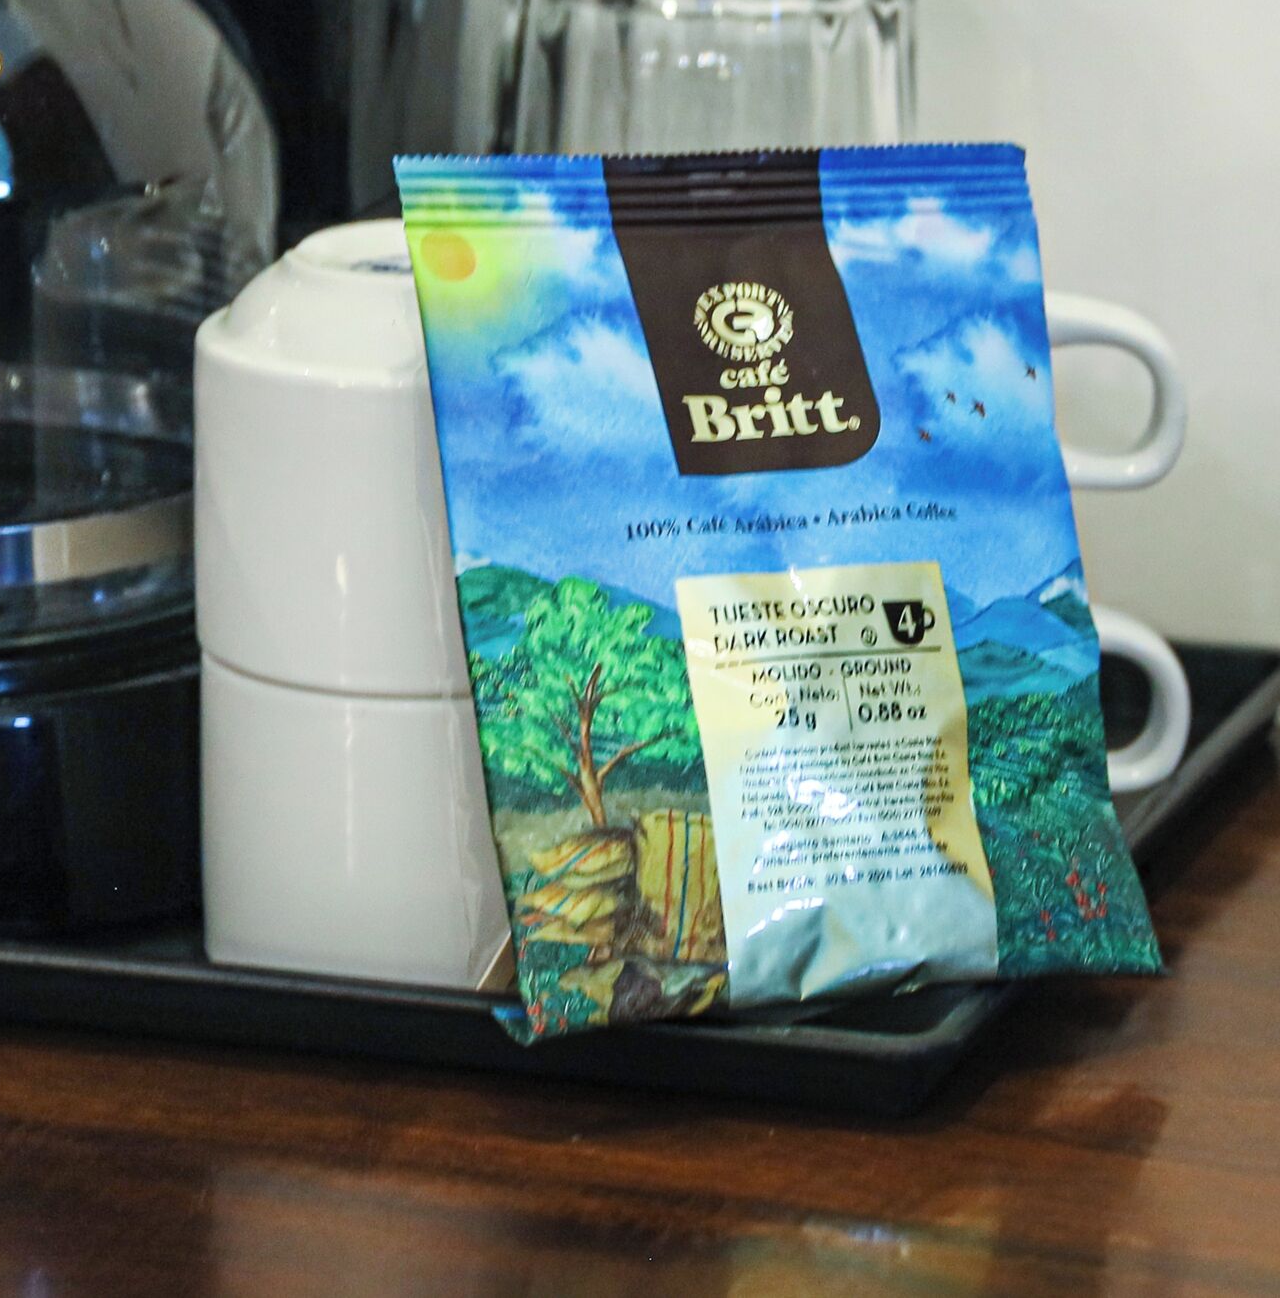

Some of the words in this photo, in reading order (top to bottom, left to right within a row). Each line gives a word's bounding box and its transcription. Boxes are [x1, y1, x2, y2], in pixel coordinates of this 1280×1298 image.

[720, 358, 790, 389] café
[682, 386, 849, 442] Britt
[625, 518, 680, 542] 100%
[686, 514, 726, 535] Café
[828, 505, 901, 527] Arabica
[906, 501, 957, 521] Coffee
[708, 601, 784, 626] TUESTE
[790, 594, 874, 619] OSCURO
[897, 604, 916, 638] 4
[714, 628, 770, 653] DARK
[776, 624, 838, 647] ROAST
[752, 663, 821, 685] MOLIDO
[841, 657, 911, 679] GROUND
[859, 680, 885, 697] Net
[775, 706, 799, 730] 25
[805, 711, 816, 732] g
[858, 703, 901, 724] 0.88
[907, 705, 927, 720] oz
